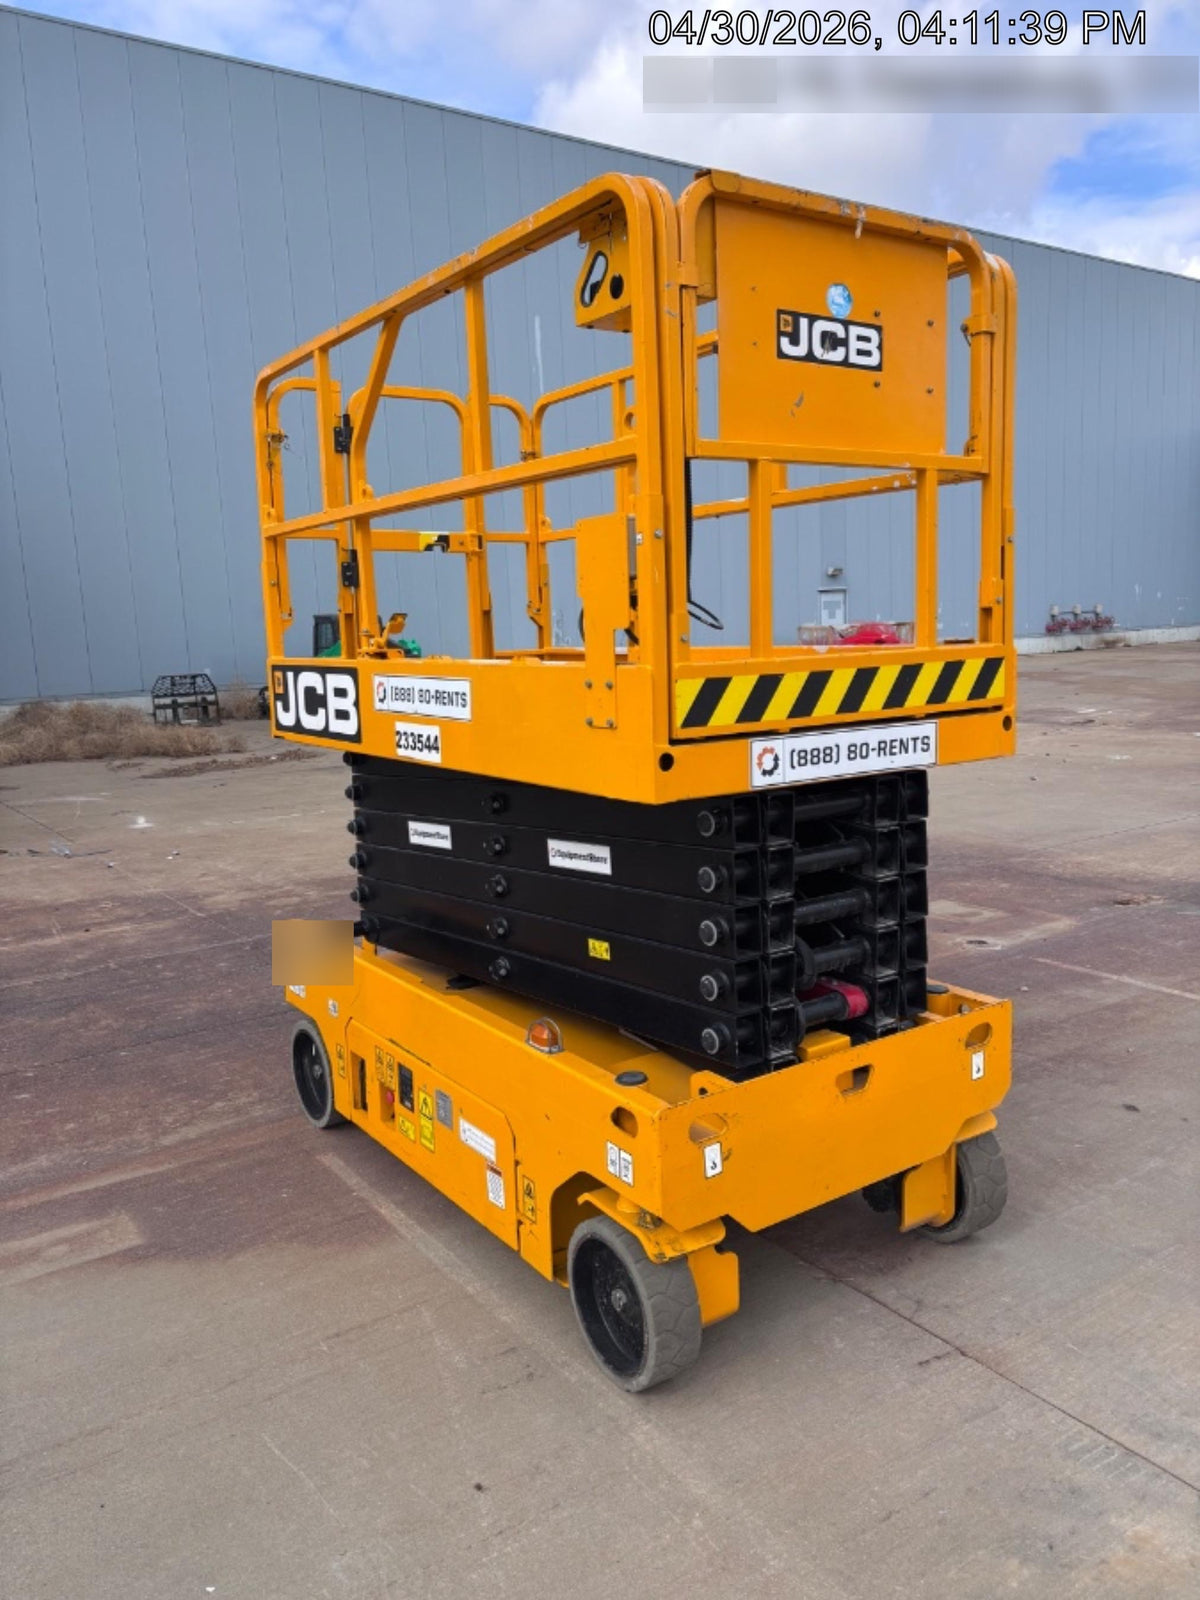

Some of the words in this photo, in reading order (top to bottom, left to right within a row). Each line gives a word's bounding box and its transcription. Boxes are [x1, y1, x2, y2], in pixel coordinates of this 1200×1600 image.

[780, 316, 881, 367] JCB
[276, 671, 359, 735] JCB
[418, 688, 468, 708] 80-RENTS
[395, 730, 440, 754] 233544
[790, 744, 840, 769] (888)
[847, 735, 931, 761] 80-RENTS
